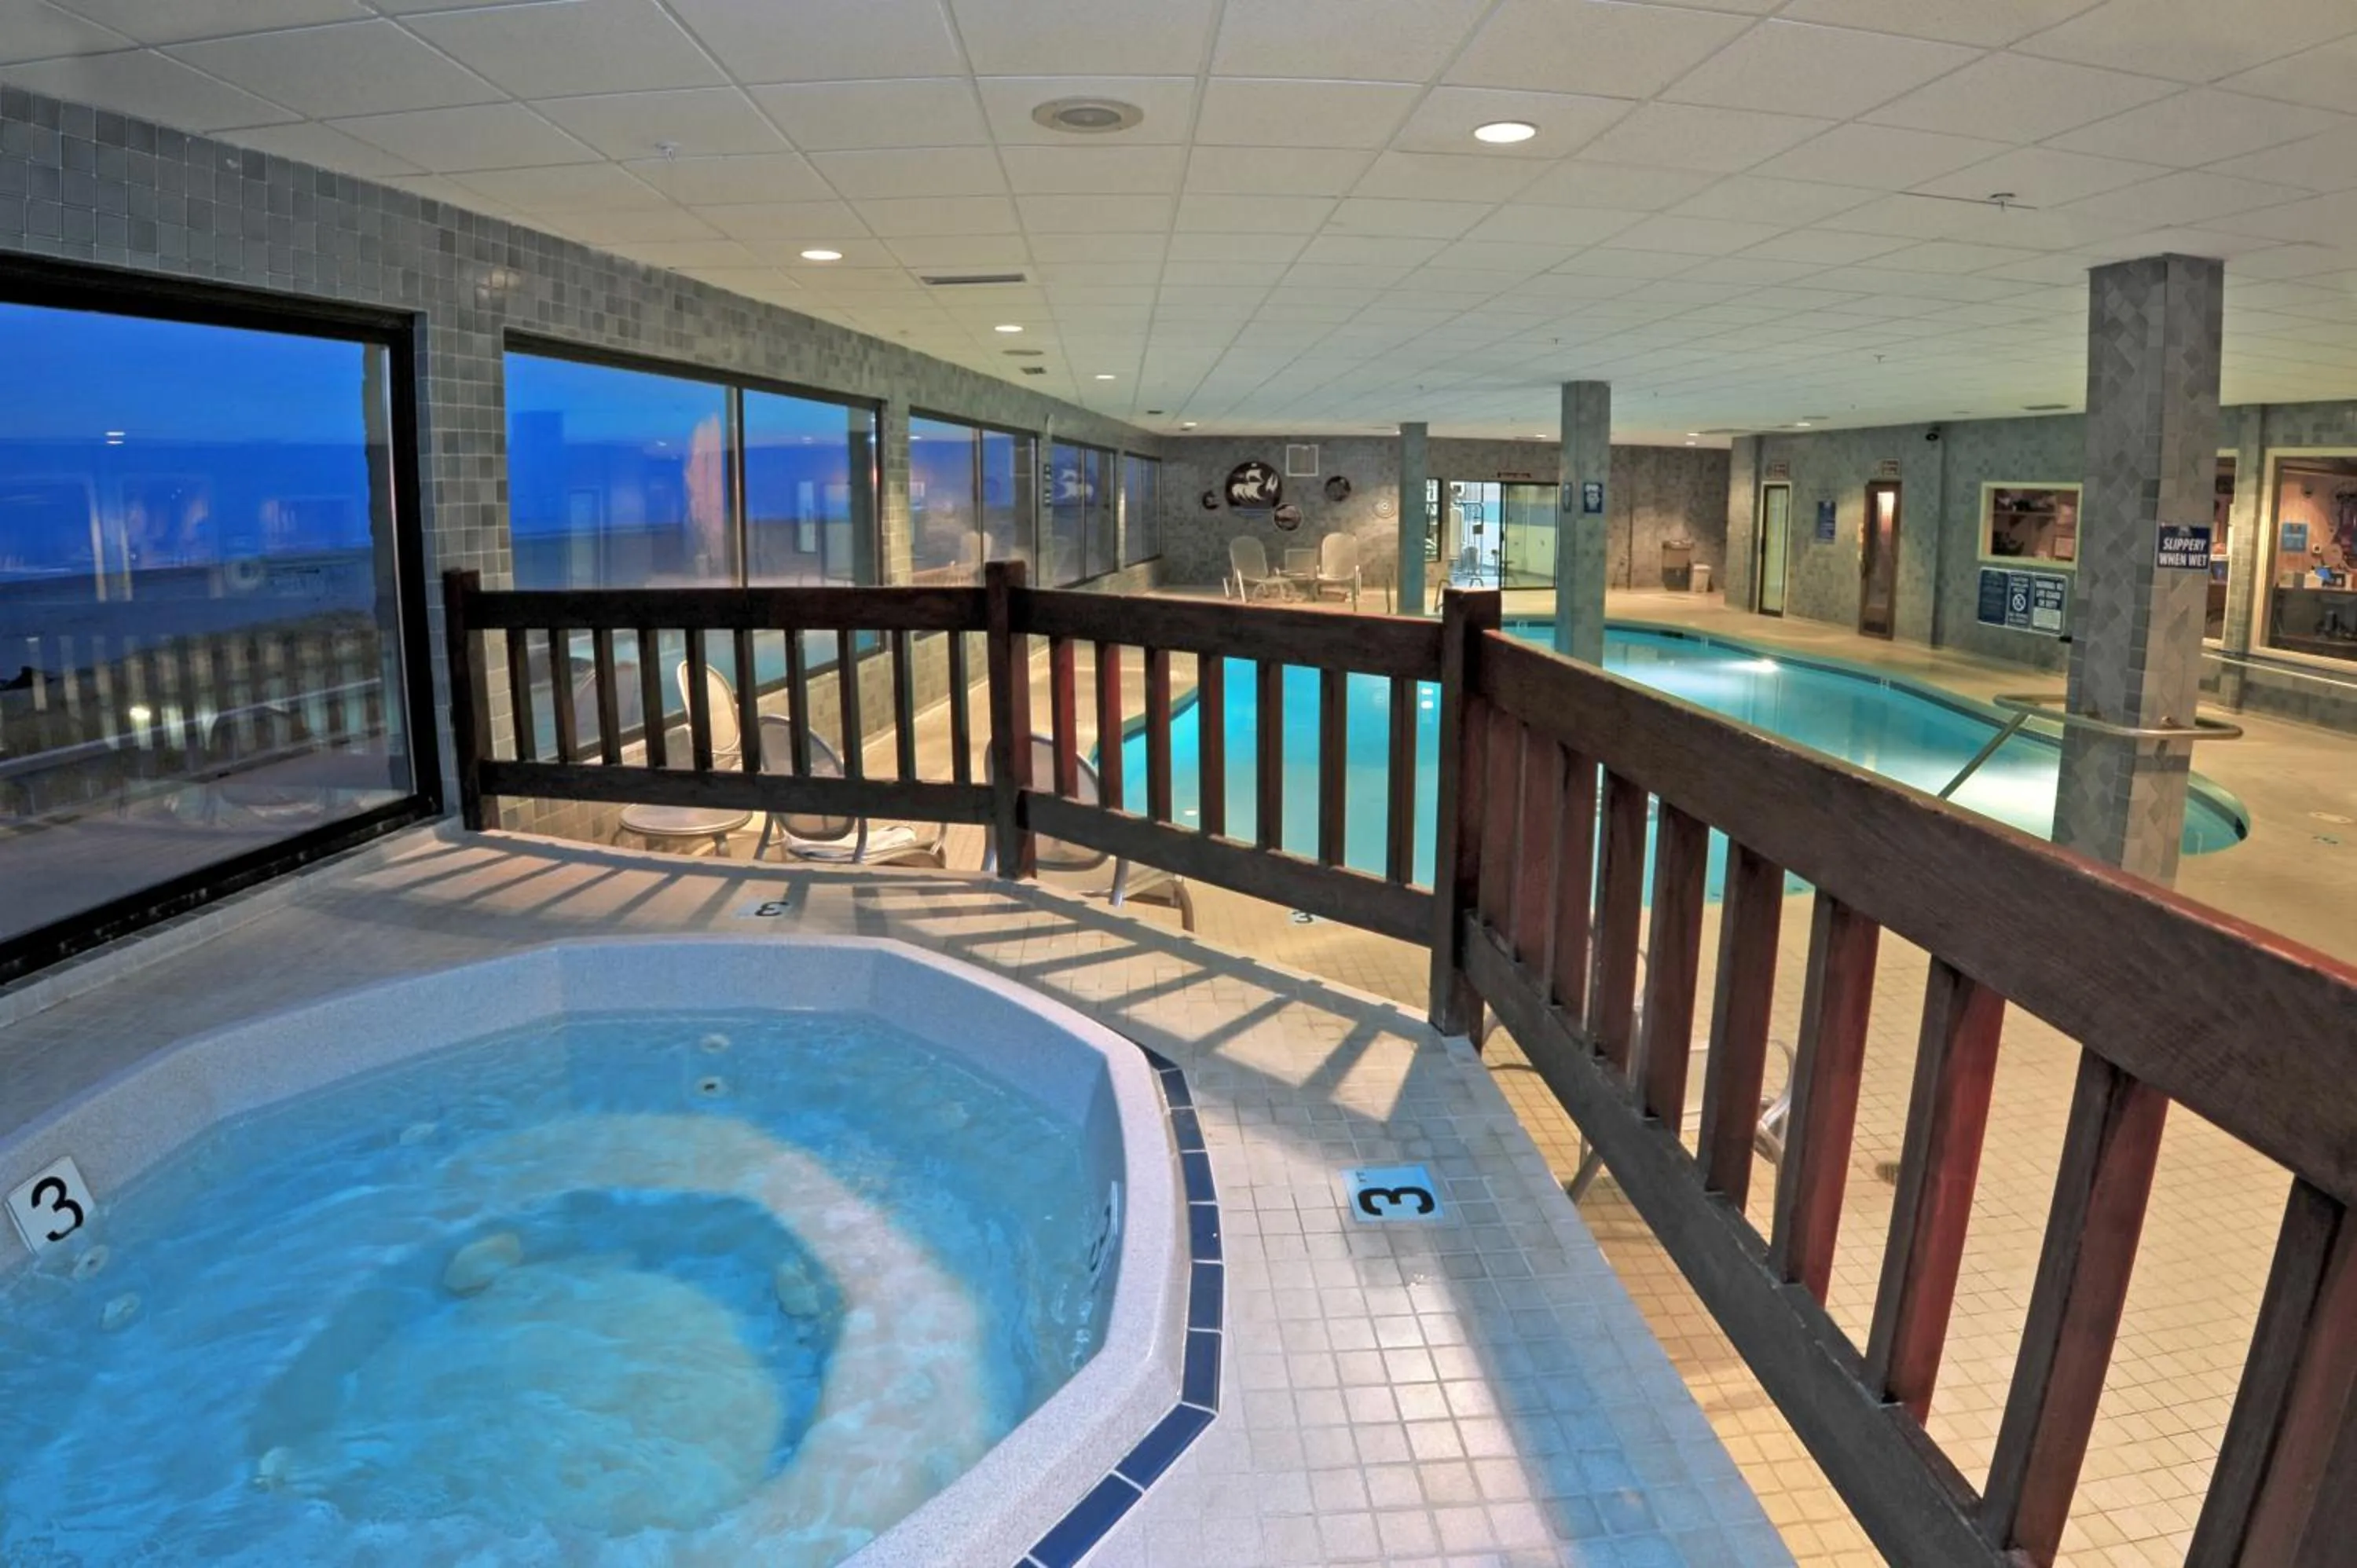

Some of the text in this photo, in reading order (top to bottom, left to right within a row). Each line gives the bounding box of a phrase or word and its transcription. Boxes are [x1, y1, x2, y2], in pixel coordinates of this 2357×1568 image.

[2163, 537, 2206, 551] SLIPPERY
[2159, 553, 2208, 566] WHEN WET
[755, 901, 789, 917] 3
[1292, 910, 1314, 924] 3
[31, 1176, 84, 1241] 3
[1358, 1187, 1435, 1217] 3
